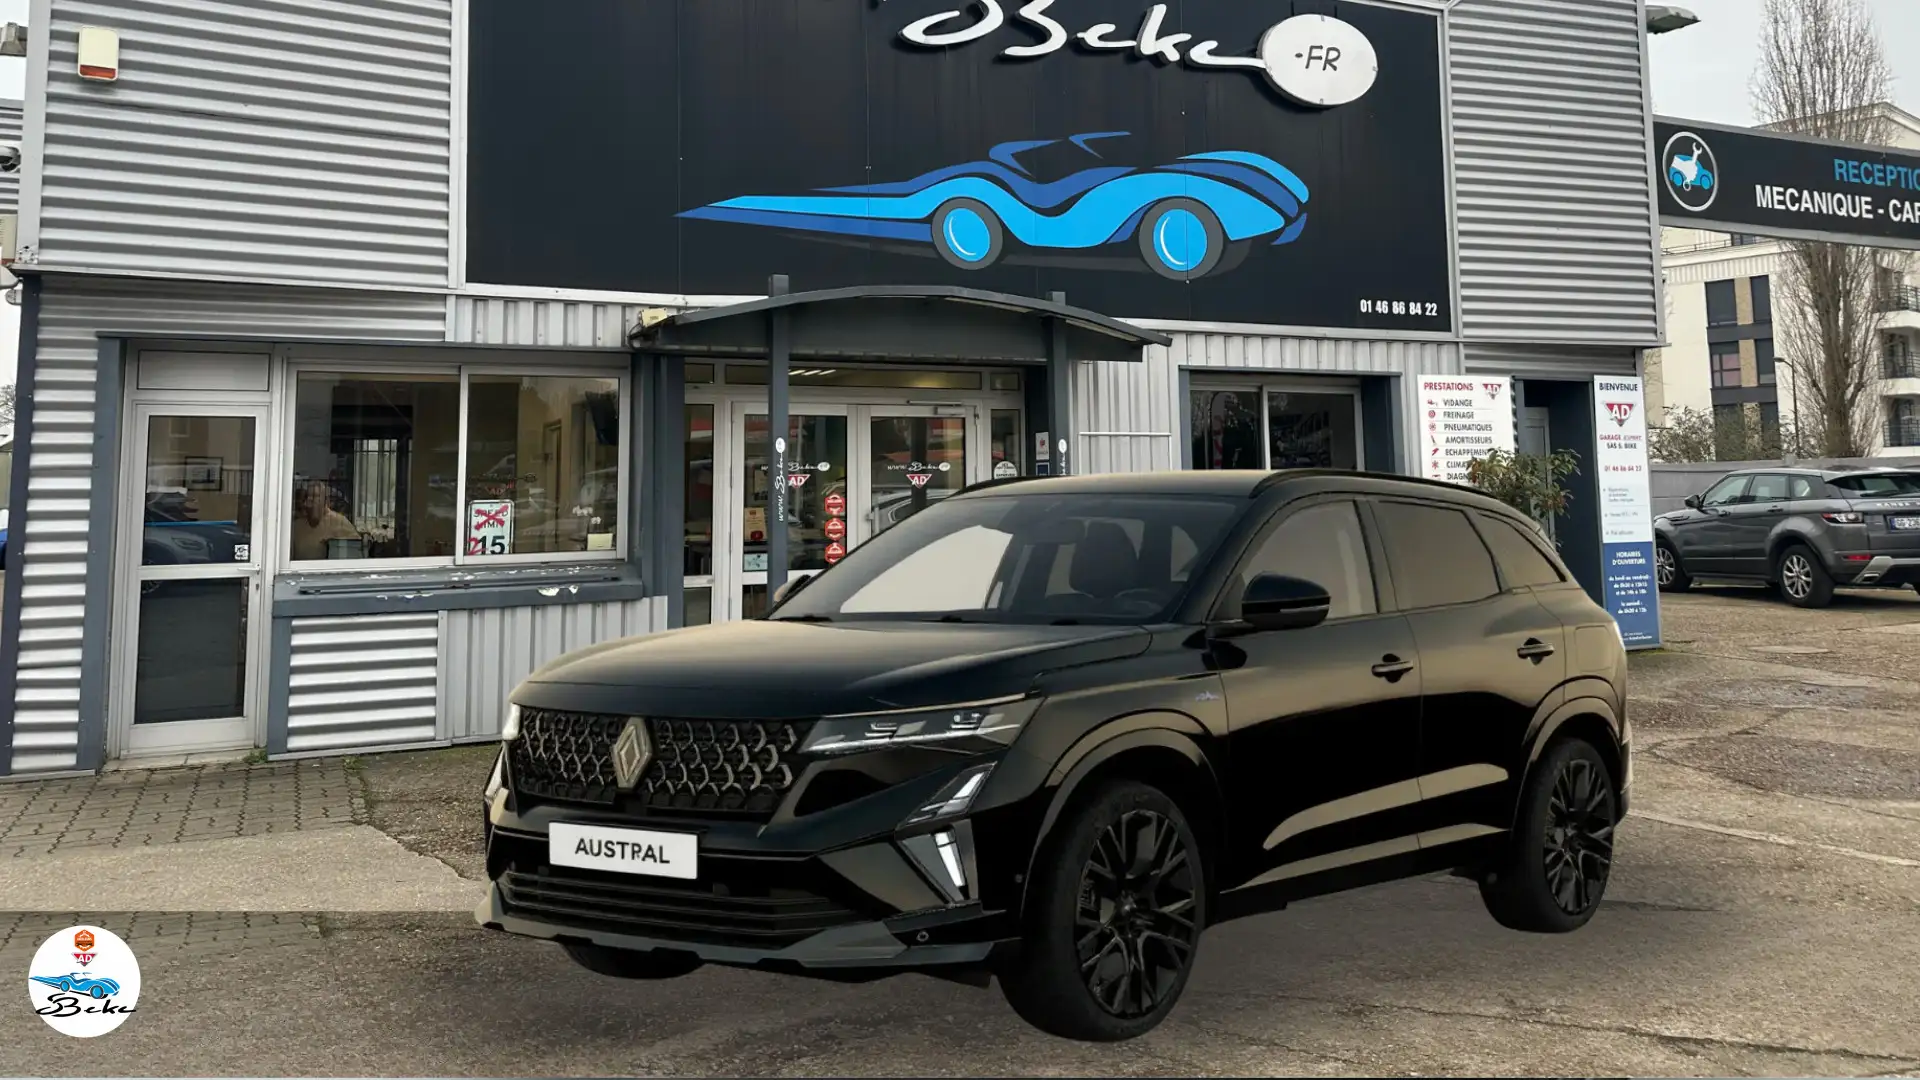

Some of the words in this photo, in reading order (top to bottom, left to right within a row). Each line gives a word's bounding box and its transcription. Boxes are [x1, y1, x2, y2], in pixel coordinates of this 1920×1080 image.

[1755, 184, 1874, 219] MECANIQUE
[1360, 299, 1372, 313] 01
[1375, 300, 1388, 314] 46
[1392, 301, 1405, 315] 86
[1409, 302, 1422, 315] 84
[1425, 302, 1438, 316] 22
[1424, 382, 1474, 391] PRESTATIONS
[1599, 383, 1638, 392] BIENVENUE
[1443, 399, 1473, 407] VIDANGE
[1443, 411, 1474, 419] FREINAGE
[1612, 404, 1630, 419] AD
[1444, 423, 1492, 432] PNEUMATIQUES
[1445, 436, 1493, 444] AMORTISSEURS
[911, 475, 927, 486] AD
[575, 838, 670, 864] AUSTRAL
